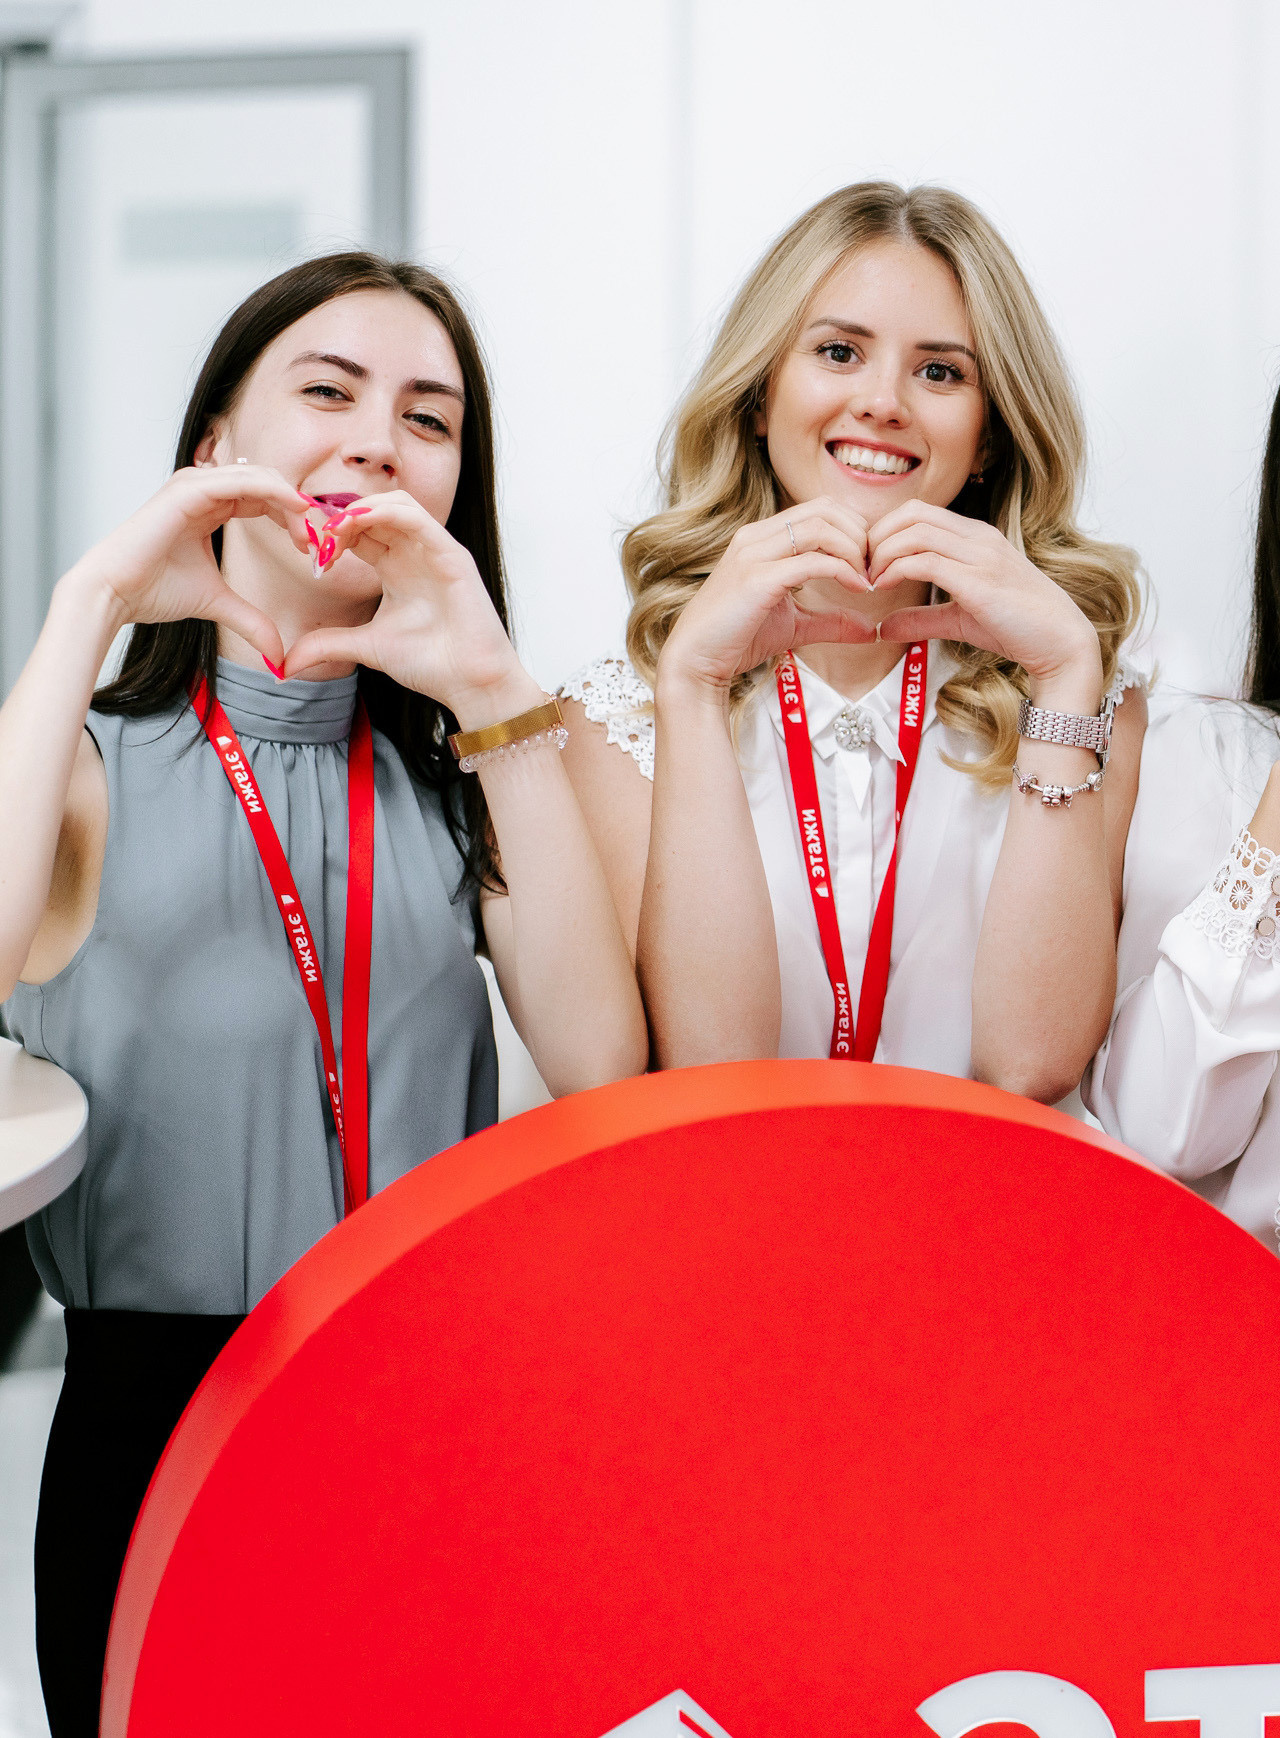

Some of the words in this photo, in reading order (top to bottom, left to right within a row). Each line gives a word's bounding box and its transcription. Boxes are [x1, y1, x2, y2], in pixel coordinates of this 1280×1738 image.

[904, 662, 922, 728] этажи
[224, 750, 262, 814] этажи
[801, 808, 828, 879] этажи
[288, 913, 318, 983] этажи
[836, 982, 850, 1054] этажи
